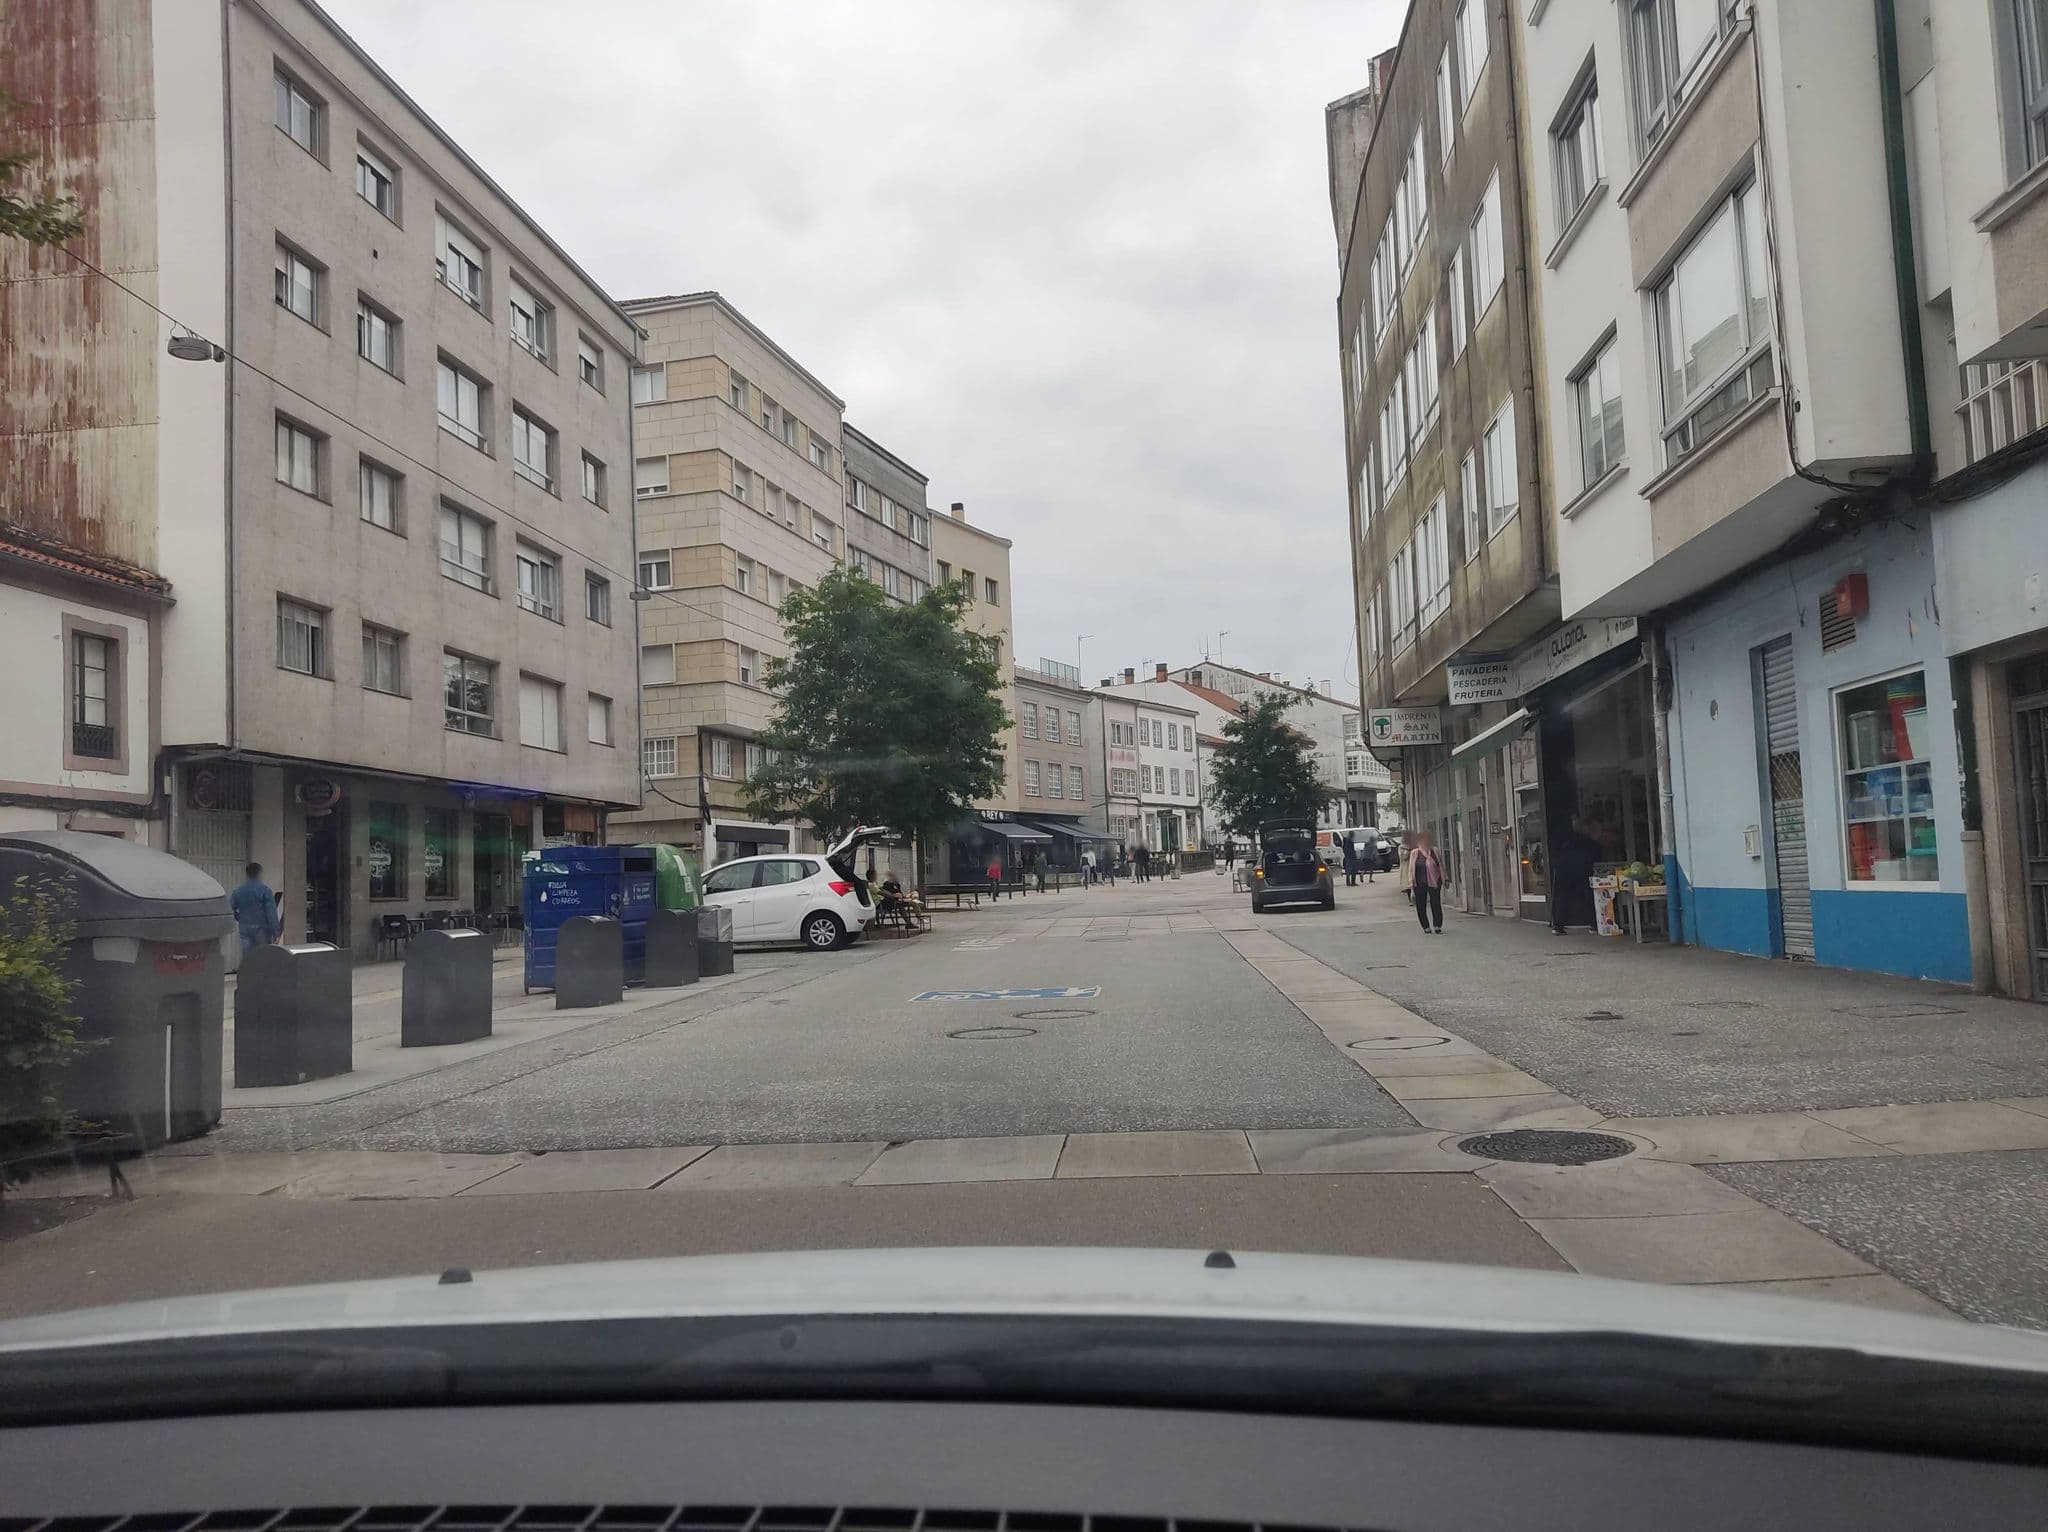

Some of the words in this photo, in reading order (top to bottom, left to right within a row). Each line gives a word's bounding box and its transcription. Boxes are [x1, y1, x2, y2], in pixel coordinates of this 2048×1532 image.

[1452, 664, 1508, 677] PANADERIA
[1453, 677, 1507, 688] PESCADERIA
[1454, 689, 1503, 700] FRUTERIA
[1394, 711, 1437, 721] IMPRENTA
[1403, 723, 1429, 731] SAN
[1391, 732, 1439, 743] MARTIN
